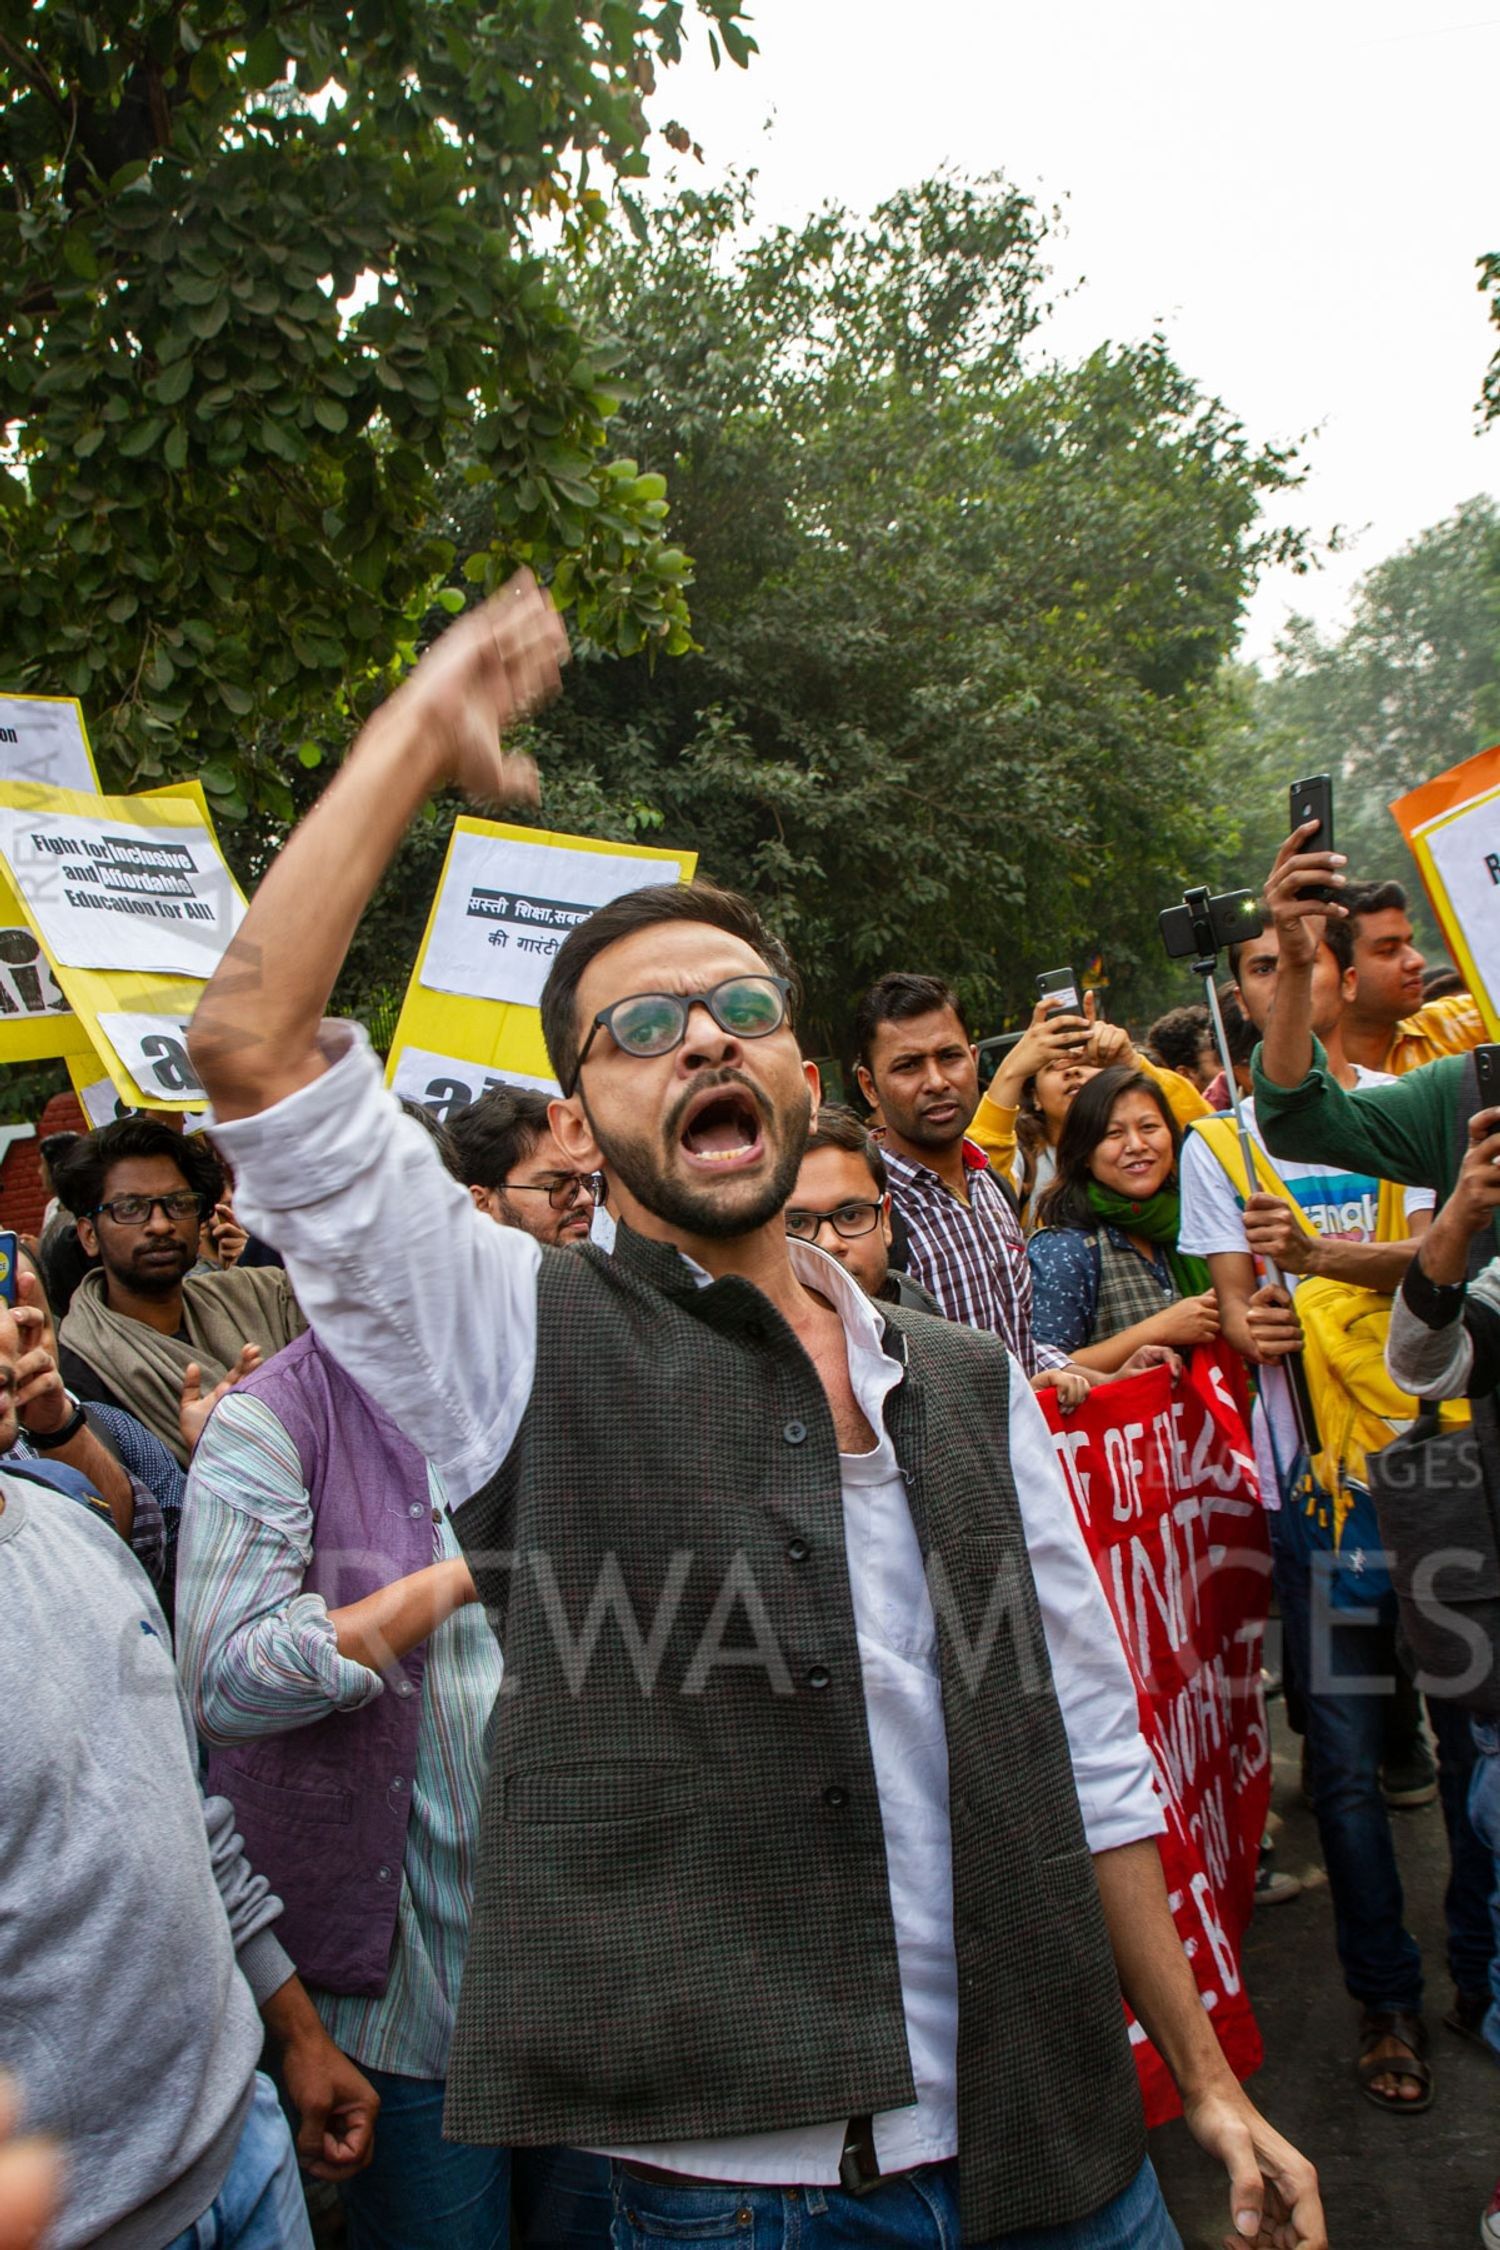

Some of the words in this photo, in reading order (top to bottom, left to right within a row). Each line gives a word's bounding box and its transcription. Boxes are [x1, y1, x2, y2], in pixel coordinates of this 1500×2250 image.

[31, 834, 82, 856] Fight
[82, 840, 109, 860] for
[107, 842, 194, 870] Inclusive
[62, 864, 100, 884] and
[99, 866, 193, 895] Affordable
[64, 889, 158, 917] Education
[156, 898, 183, 919] for
[184, 902, 216, 921] All!
[468, 896, 510, 915] सस्ती
[487, 929, 510, 949] की
[1104, 1422, 1144, 1523] OF
